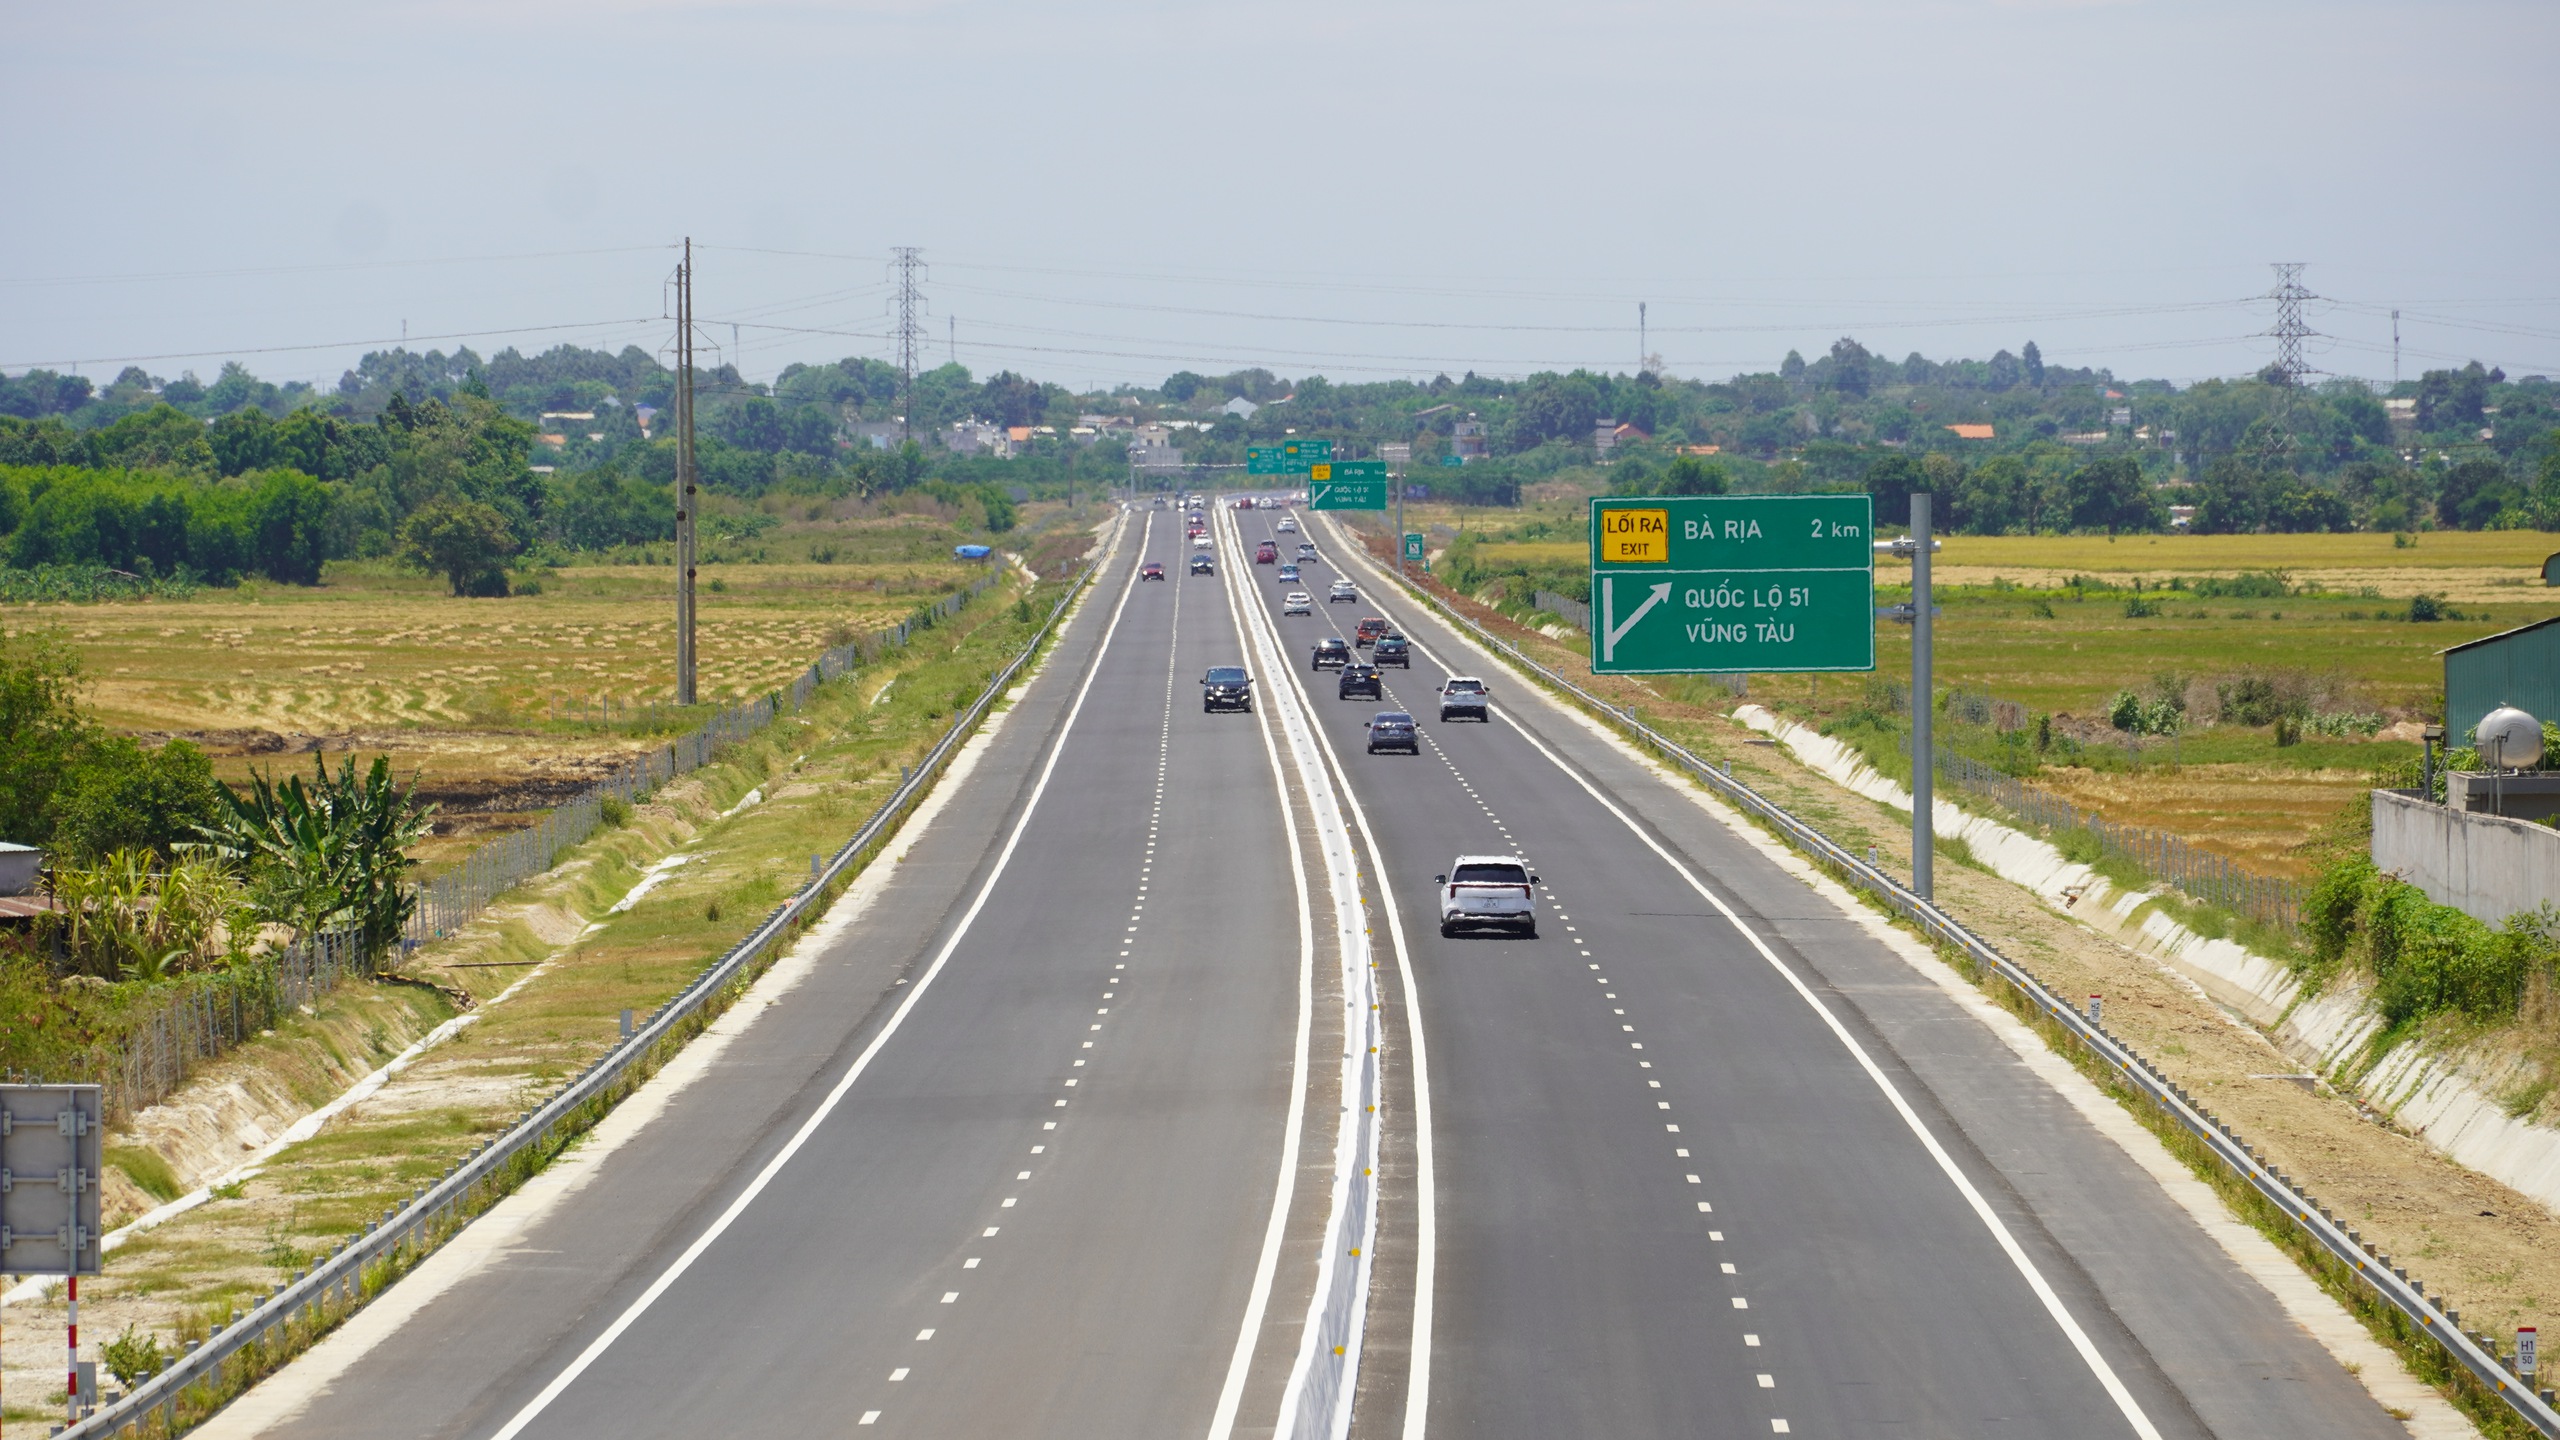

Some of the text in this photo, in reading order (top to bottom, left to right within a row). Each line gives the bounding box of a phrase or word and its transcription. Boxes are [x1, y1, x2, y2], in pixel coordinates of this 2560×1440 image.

[1607, 514, 1664, 534] LỐI RA
[1684, 514, 1763, 544] BÀ RỊA
[1811, 519, 1860, 538] 2 km
[1621, 543, 1650, 556] EXIT
[1684, 579, 1809, 612] QUỐC LỘ 51
[1686, 617, 1795, 643] VŨNG TÀU
[2521, 1340, 2533, 1351] H1
[2522, 1356, 2532, 1364] 50
